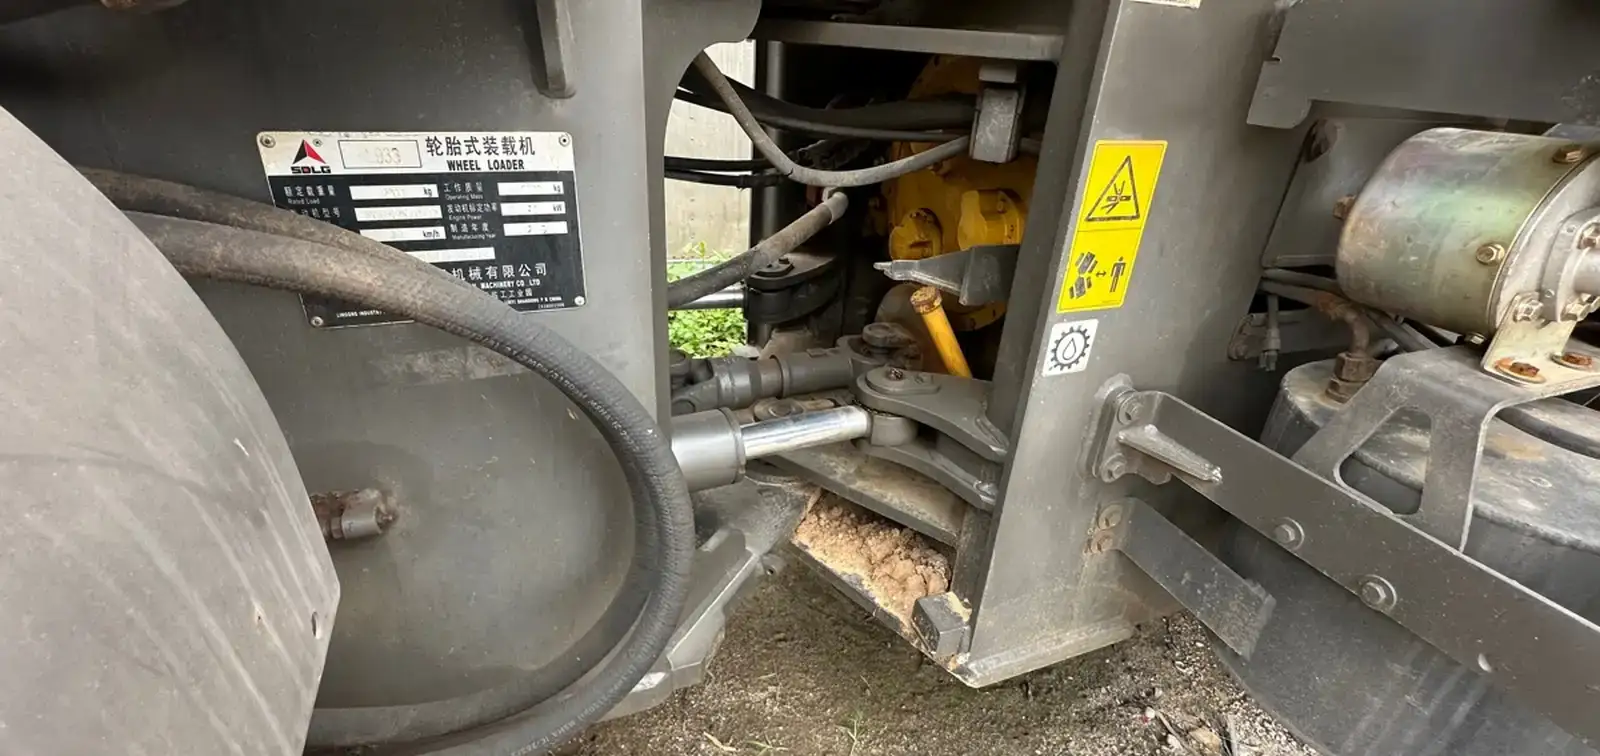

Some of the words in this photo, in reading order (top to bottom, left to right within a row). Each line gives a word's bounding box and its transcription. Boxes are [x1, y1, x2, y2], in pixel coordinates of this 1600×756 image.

[425, 136, 535, 156] 轮胎式装载机
[291, 165, 331, 174] SDLG
[446, 159, 481, 171] WHEEL
[487, 159, 525, 170] LOADER
[423, 187, 432, 196] kg
[552, 183, 561, 193] kg
[552, 204, 562, 212] kW
[422, 229, 441, 239] km/h
[451, 262, 547, 281] 机械有限公司
